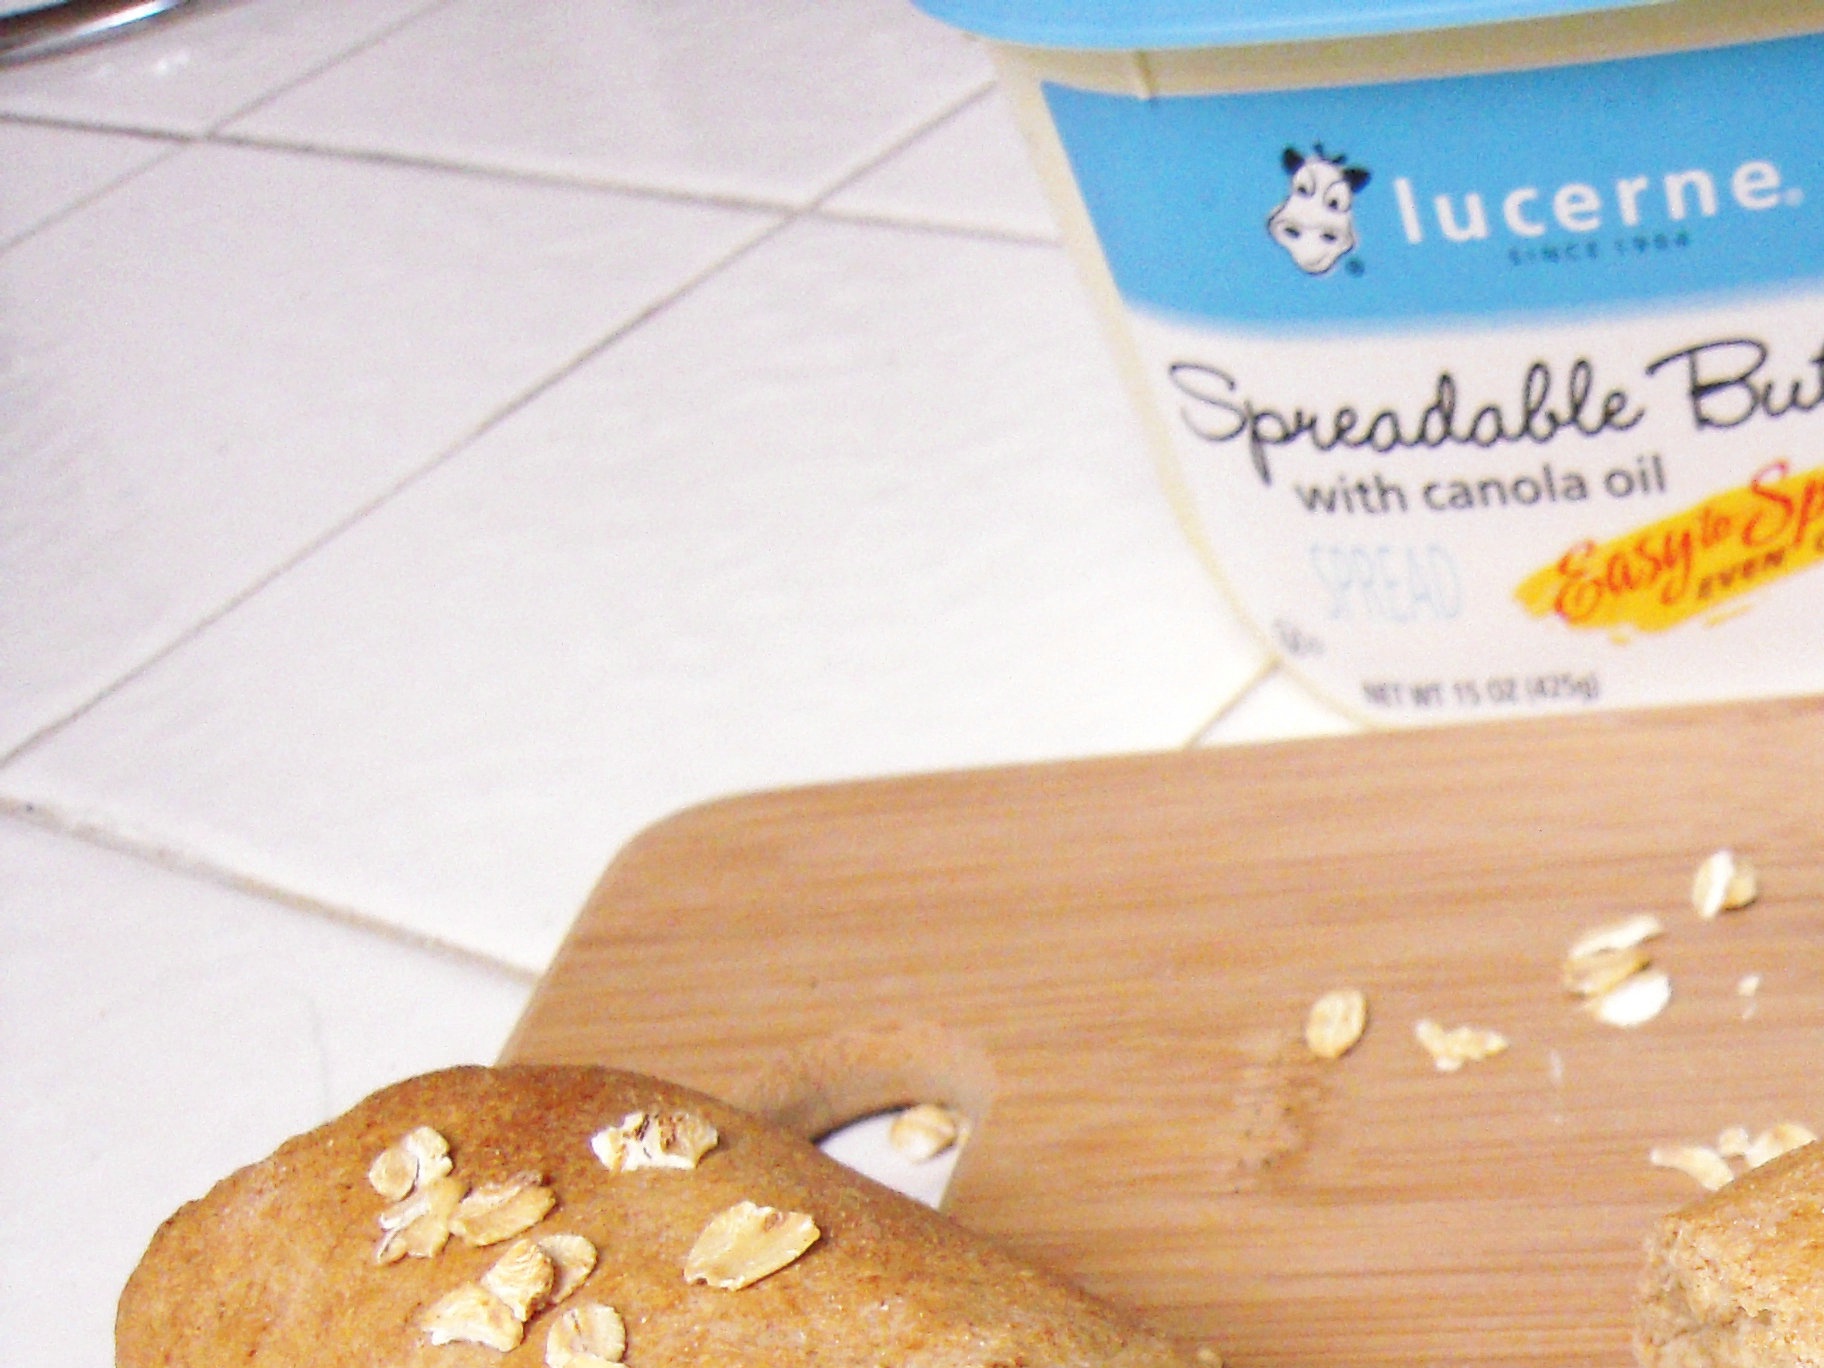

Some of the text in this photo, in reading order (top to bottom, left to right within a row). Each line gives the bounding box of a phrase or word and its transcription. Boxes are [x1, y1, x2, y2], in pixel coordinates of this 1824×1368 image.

[1169, 356, 1646, 487] Spreadable
[1293, 452, 1667, 516] with canola oil
[1308, 542, 1463, 622] SPREAD
[1554, 529, 1694, 624] Easy
[1700, 507, 1732, 549] to
[1698, 549, 1785, 600] EVEN
[1362, 680, 1404, 706] NET
[1453, 680, 1482, 706] 15
